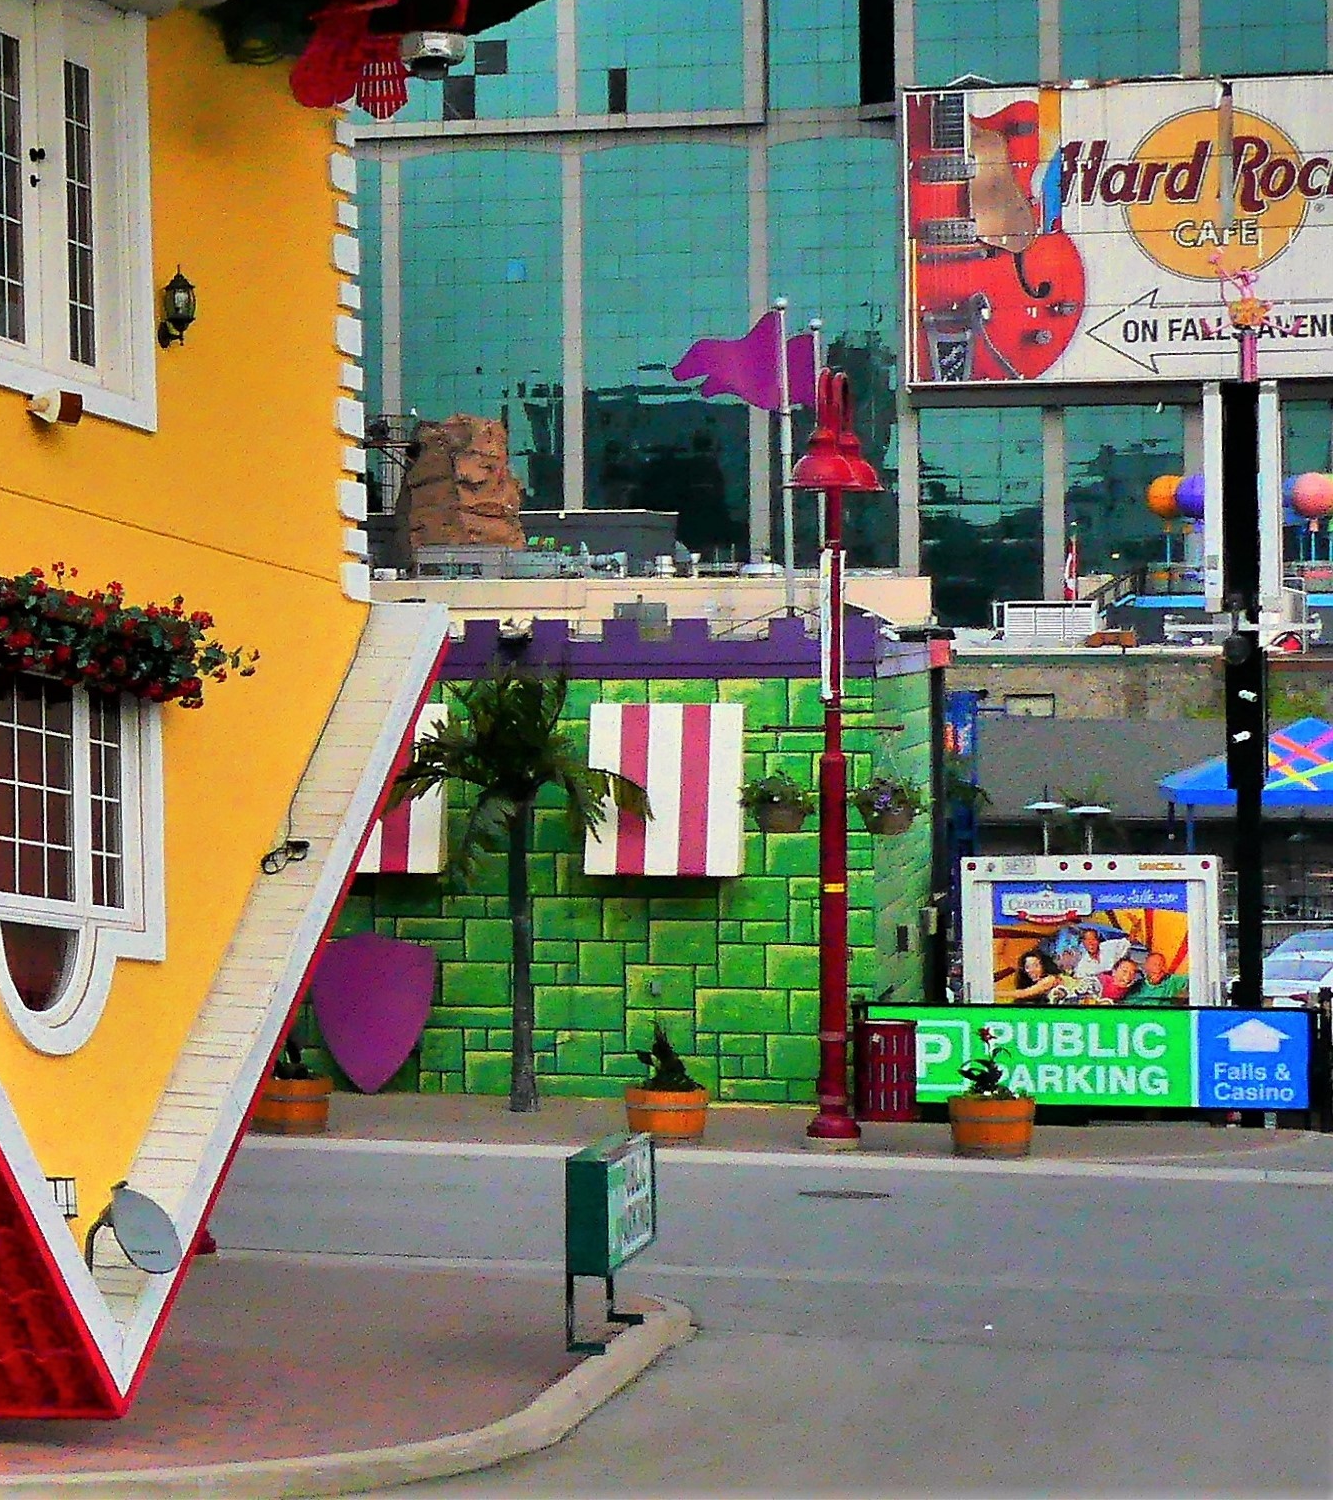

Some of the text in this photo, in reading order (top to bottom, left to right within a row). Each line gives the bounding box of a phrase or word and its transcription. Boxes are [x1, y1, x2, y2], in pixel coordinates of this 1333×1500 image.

[1061, 134, 1333, 215] Hard Roc
[1122, 318, 1158, 343] ON
[1257, 313, 1333, 338] AVEN
[916, 1033, 952, 1079] P
[984, 1021, 1167, 1059] PUBLIC
[1214, 1062, 1292, 1081] Falls &
[1214, 1082, 1295, 1102] Casino
